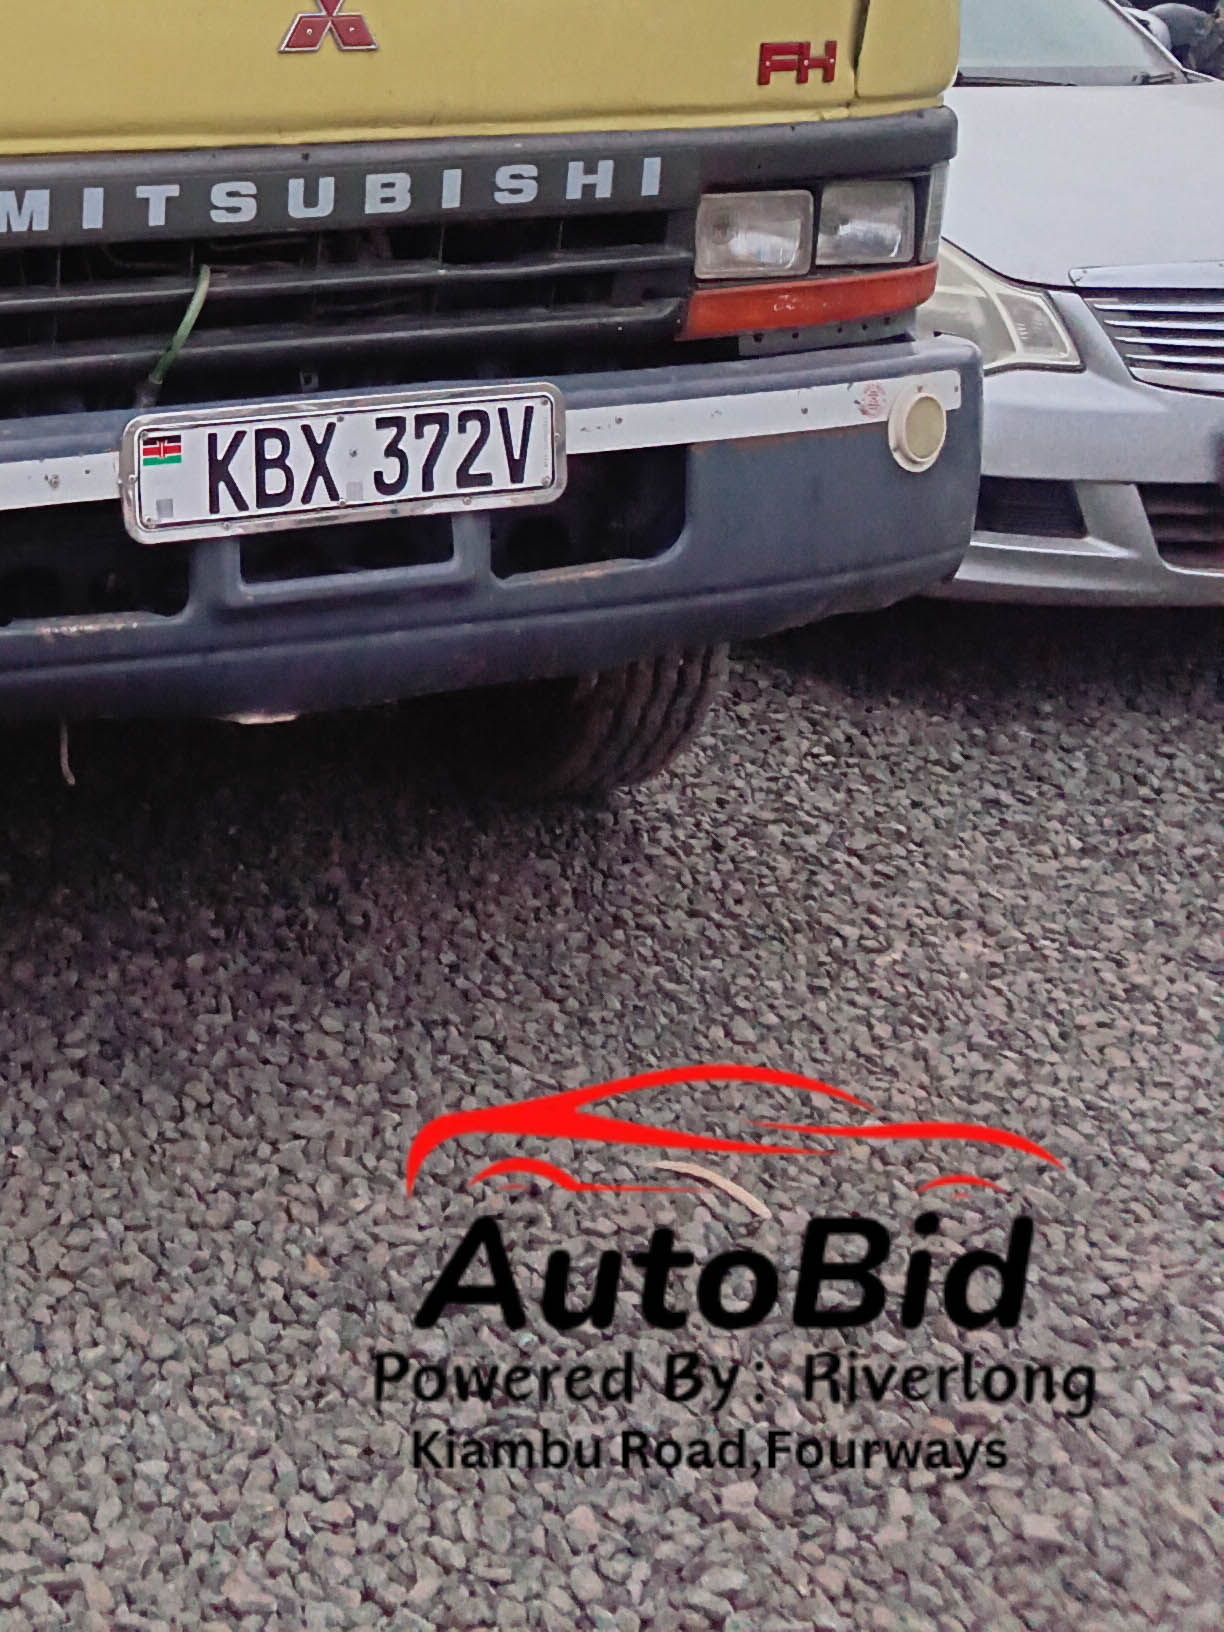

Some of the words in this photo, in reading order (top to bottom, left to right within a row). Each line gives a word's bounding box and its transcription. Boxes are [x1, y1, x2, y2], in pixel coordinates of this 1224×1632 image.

[758, 40, 837, 86] FH
[207, 421, 341, 515] KBX
[373, 405, 535, 496] 372V
